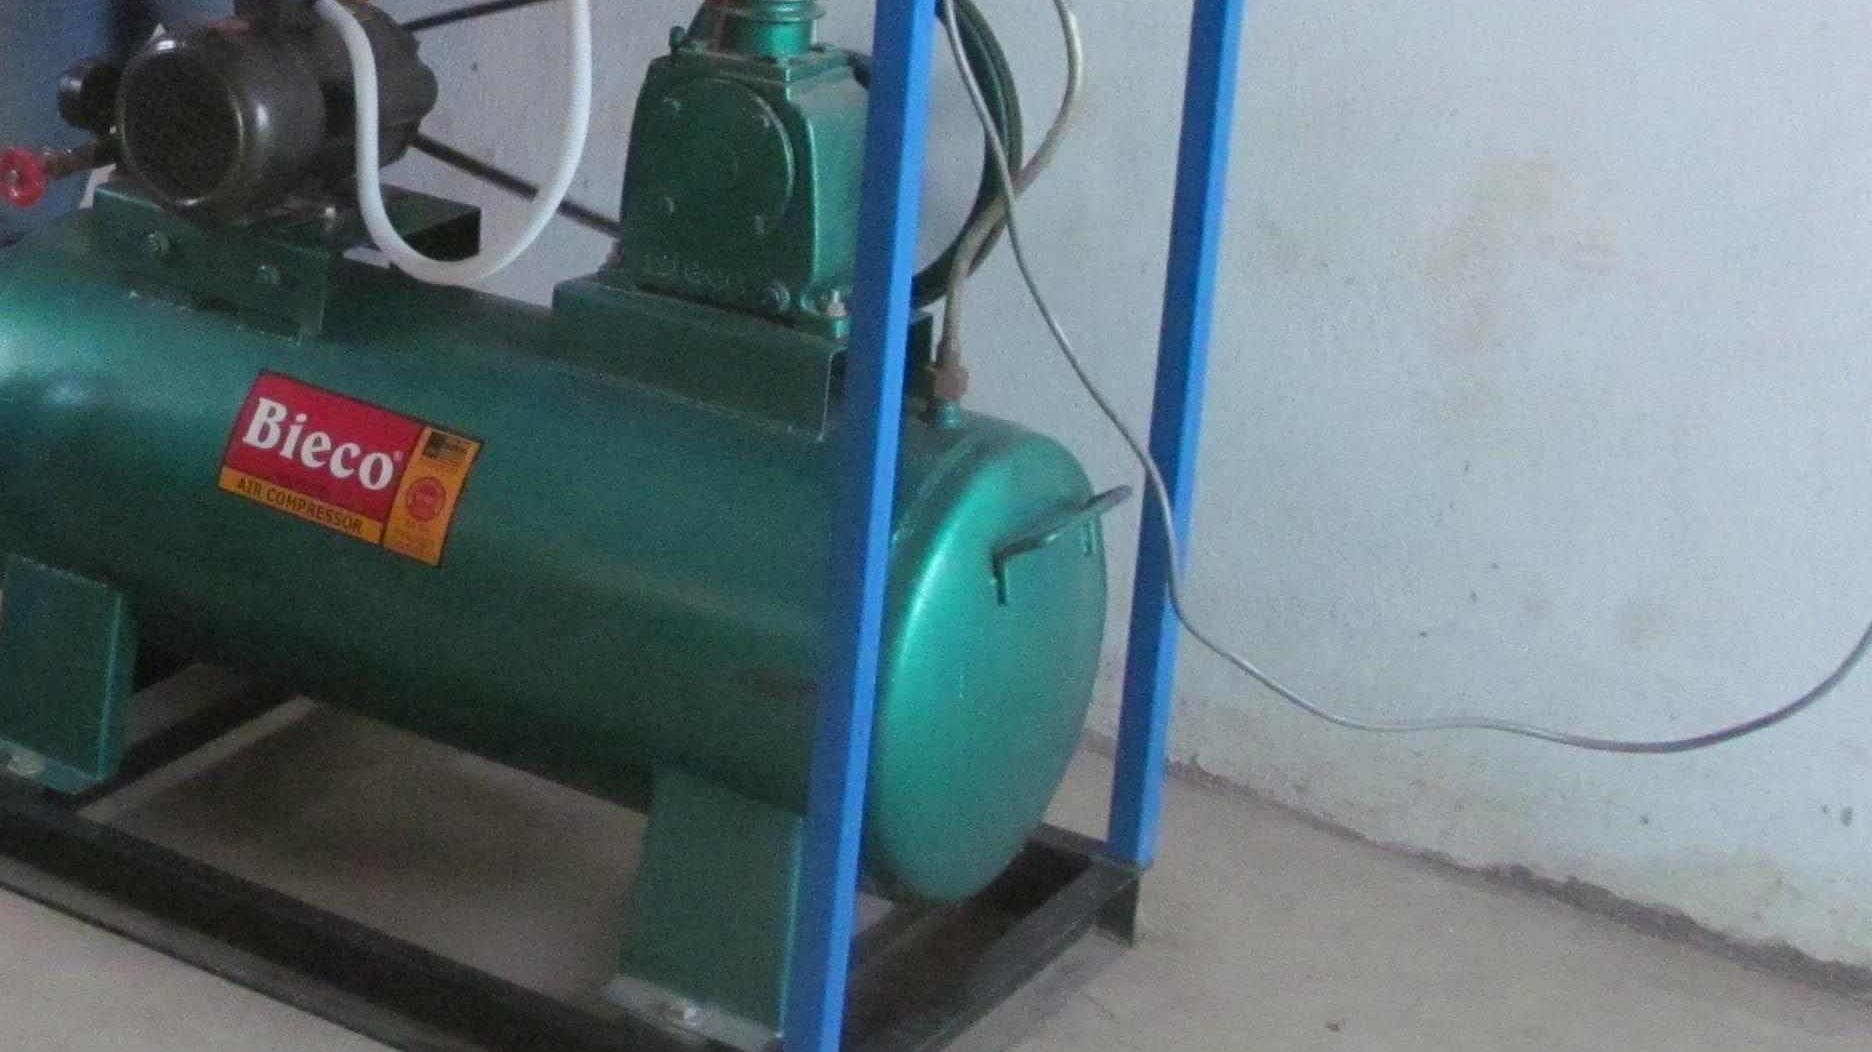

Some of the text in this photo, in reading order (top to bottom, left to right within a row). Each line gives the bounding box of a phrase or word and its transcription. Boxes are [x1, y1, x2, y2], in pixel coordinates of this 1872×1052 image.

[242, 397, 394, 490] Bieco
[237, 477, 363, 533] AIR COMPRESSOR
